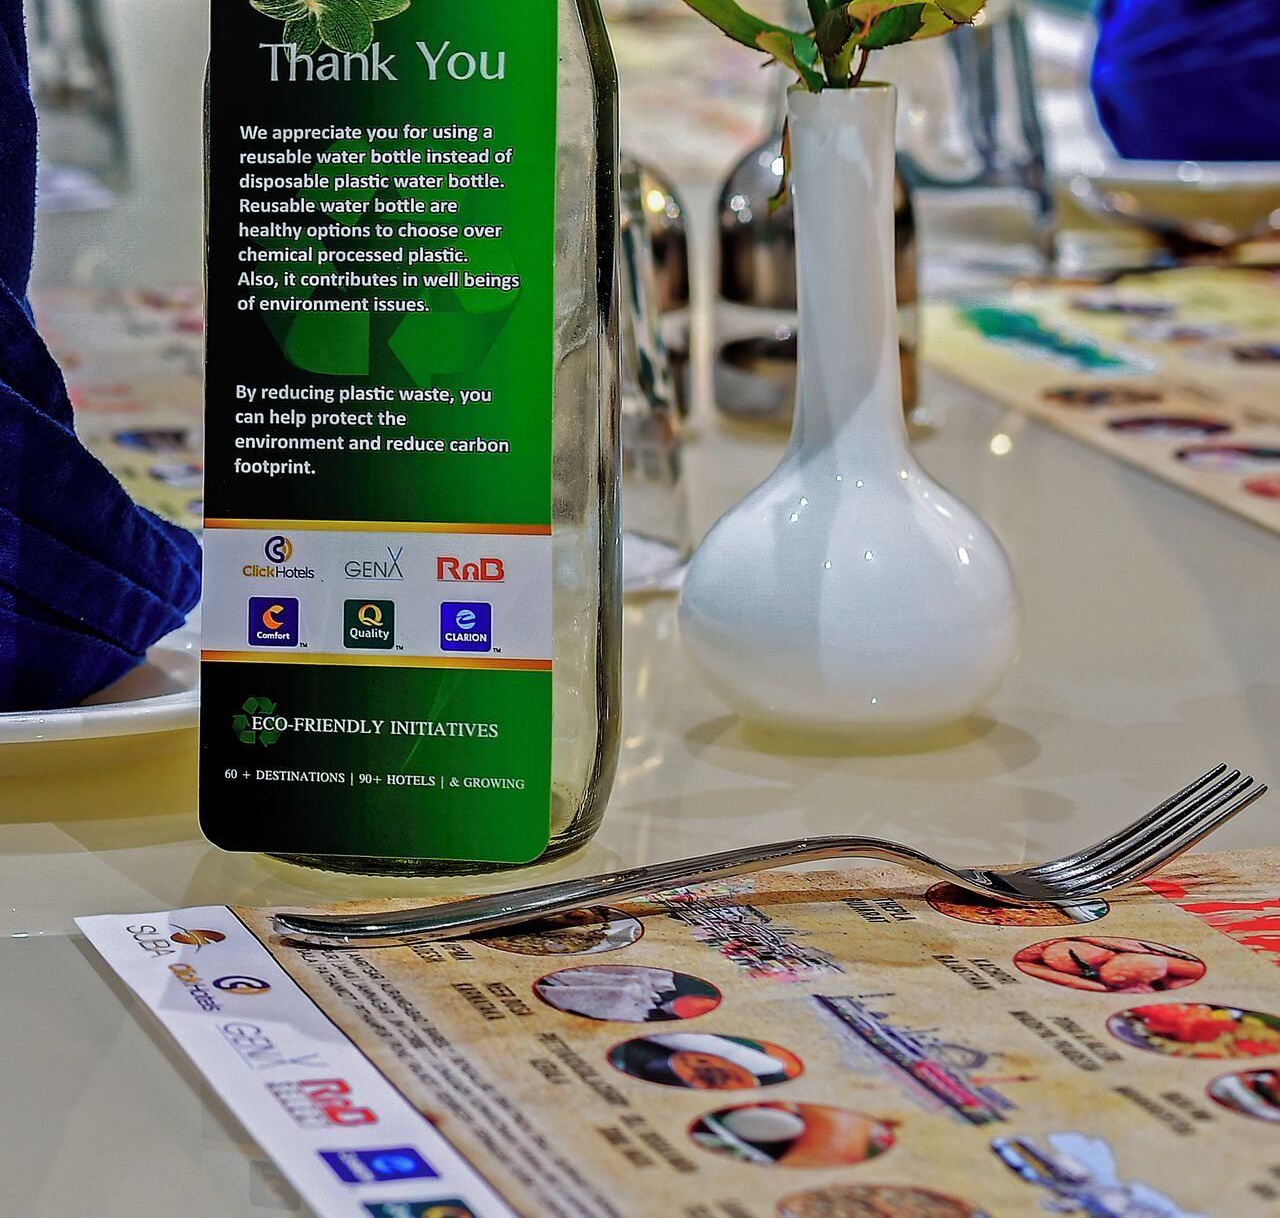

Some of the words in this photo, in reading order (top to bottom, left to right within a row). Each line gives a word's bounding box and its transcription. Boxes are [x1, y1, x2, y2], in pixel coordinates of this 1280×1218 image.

[259, 41, 399, 82] Thank
[416, 41, 505, 81] You
[239, 125, 268, 140] We
[272, 124, 362, 143] appreciate
[366, 128, 398, 143] you
[402, 123, 428, 139] for
[432, 124, 479, 142] using
[482, 127, 493, 139] a
[239, 148, 312, 164] reusable
[316, 150, 367, 164] water
[370, 148, 422, 164] bottle
[426, 148, 489, 164] instead
[494, 148, 513, 164] of
[239, 173, 330, 192] disposable
[334, 173, 389, 192] plastic
[393, 174, 444, 189] water
[448, 172, 505, 188] bottle.
[239, 197, 316, 213] Reusable
[319, 199, 370, 213] water
[374, 197, 425, 213] bottle
[430, 200, 458, 213] are
[238, 221, 303, 241] healthy
[306, 222, 371, 241] options
[374, 224, 394, 238] to
[398, 222, 459, 238] choose
[463, 226, 503, 238] over
[238, 246, 313, 262] chemical
[317, 246, 403, 265] processed
[408, 246, 468, 266] plastic.
[237, 270, 279, 289] Also,
[284, 271, 296, 287] it
[300, 271, 398, 287] contributes
[402, 271, 418, 287] in
[422, 271, 459, 287] well
[464, 272, 520, 291] beings
[237, 295, 256, 311] of
[259, 295, 369, 312] environment
[373, 296, 430, 312] issues.
[236, 384, 257, 403] By
[261, 384, 335, 404] reducing
[339, 385, 395, 404] plastic
[398, 387, 455, 405] waste,
[459, 389, 492, 405] you
[235, 412, 265, 424] can
[269, 408, 307, 428] help
[311, 411, 374, 429] protect
[377, 410, 407, 426] the
[234, 433, 345, 450] environment
[348, 435, 381, 451] and
[386, 435, 445, 452] reduce
[449, 436, 509, 453] carbon
[233, 457, 316, 478] footprint.
[243, 565, 315, 579] ClickHotels
[256, 630, 290, 641] Comfort
[349, 627, 389, 641] Quality
[445, 632, 487, 643] CLARION
[252, 716, 384, 735] ECO-FRIENDLY
[390, 721, 498, 738] INITIATIVES
[225, 769, 238, 779] 60
[256, 770, 345, 783] DESTINATIONS
[359, 774, 382, 785] 90+
[387, 775, 435, 787] HOTELS
[449, 777, 459, 788] &
[463, 777, 524, 790] GROWING
[126, 924, 177, 959] SUBA
